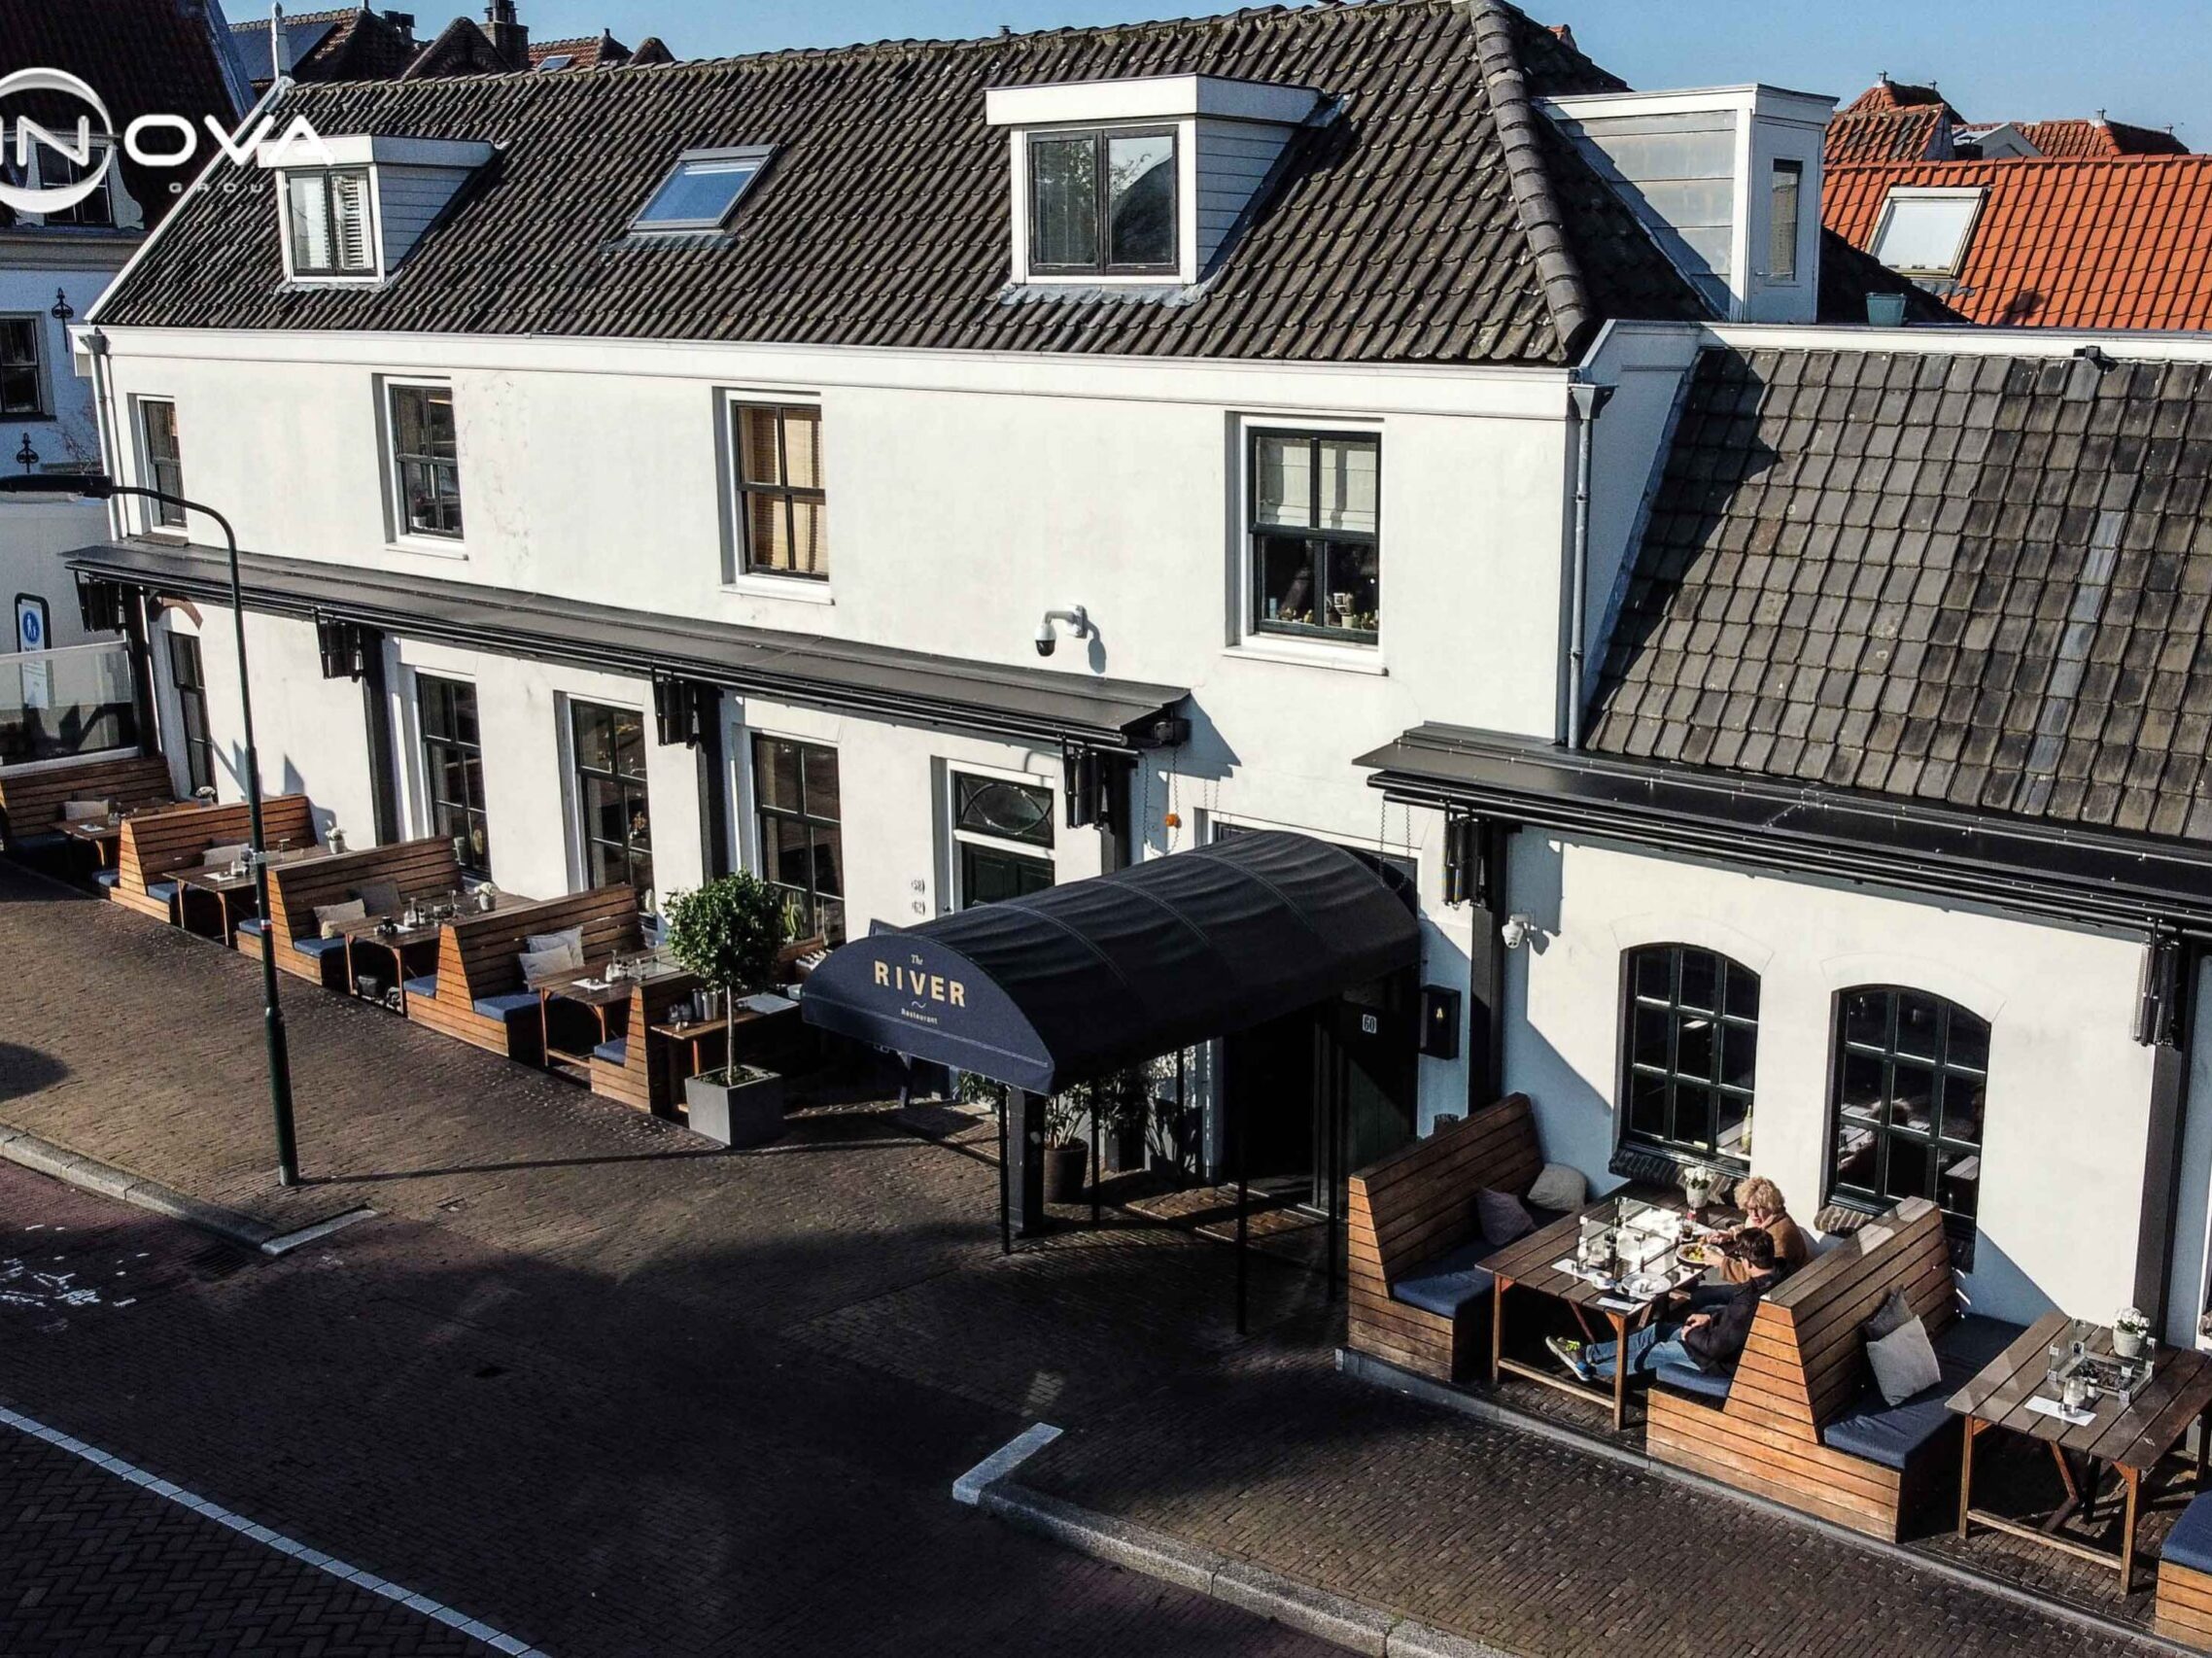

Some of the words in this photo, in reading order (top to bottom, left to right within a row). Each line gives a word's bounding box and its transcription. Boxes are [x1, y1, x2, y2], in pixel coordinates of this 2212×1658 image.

[911, 953, 923, 966] The
[874, 959, 966, 1008] RIVER
[901, 1007, 938, 1024] Restaurant
[1364, 1016, 1375, 1031] 60
